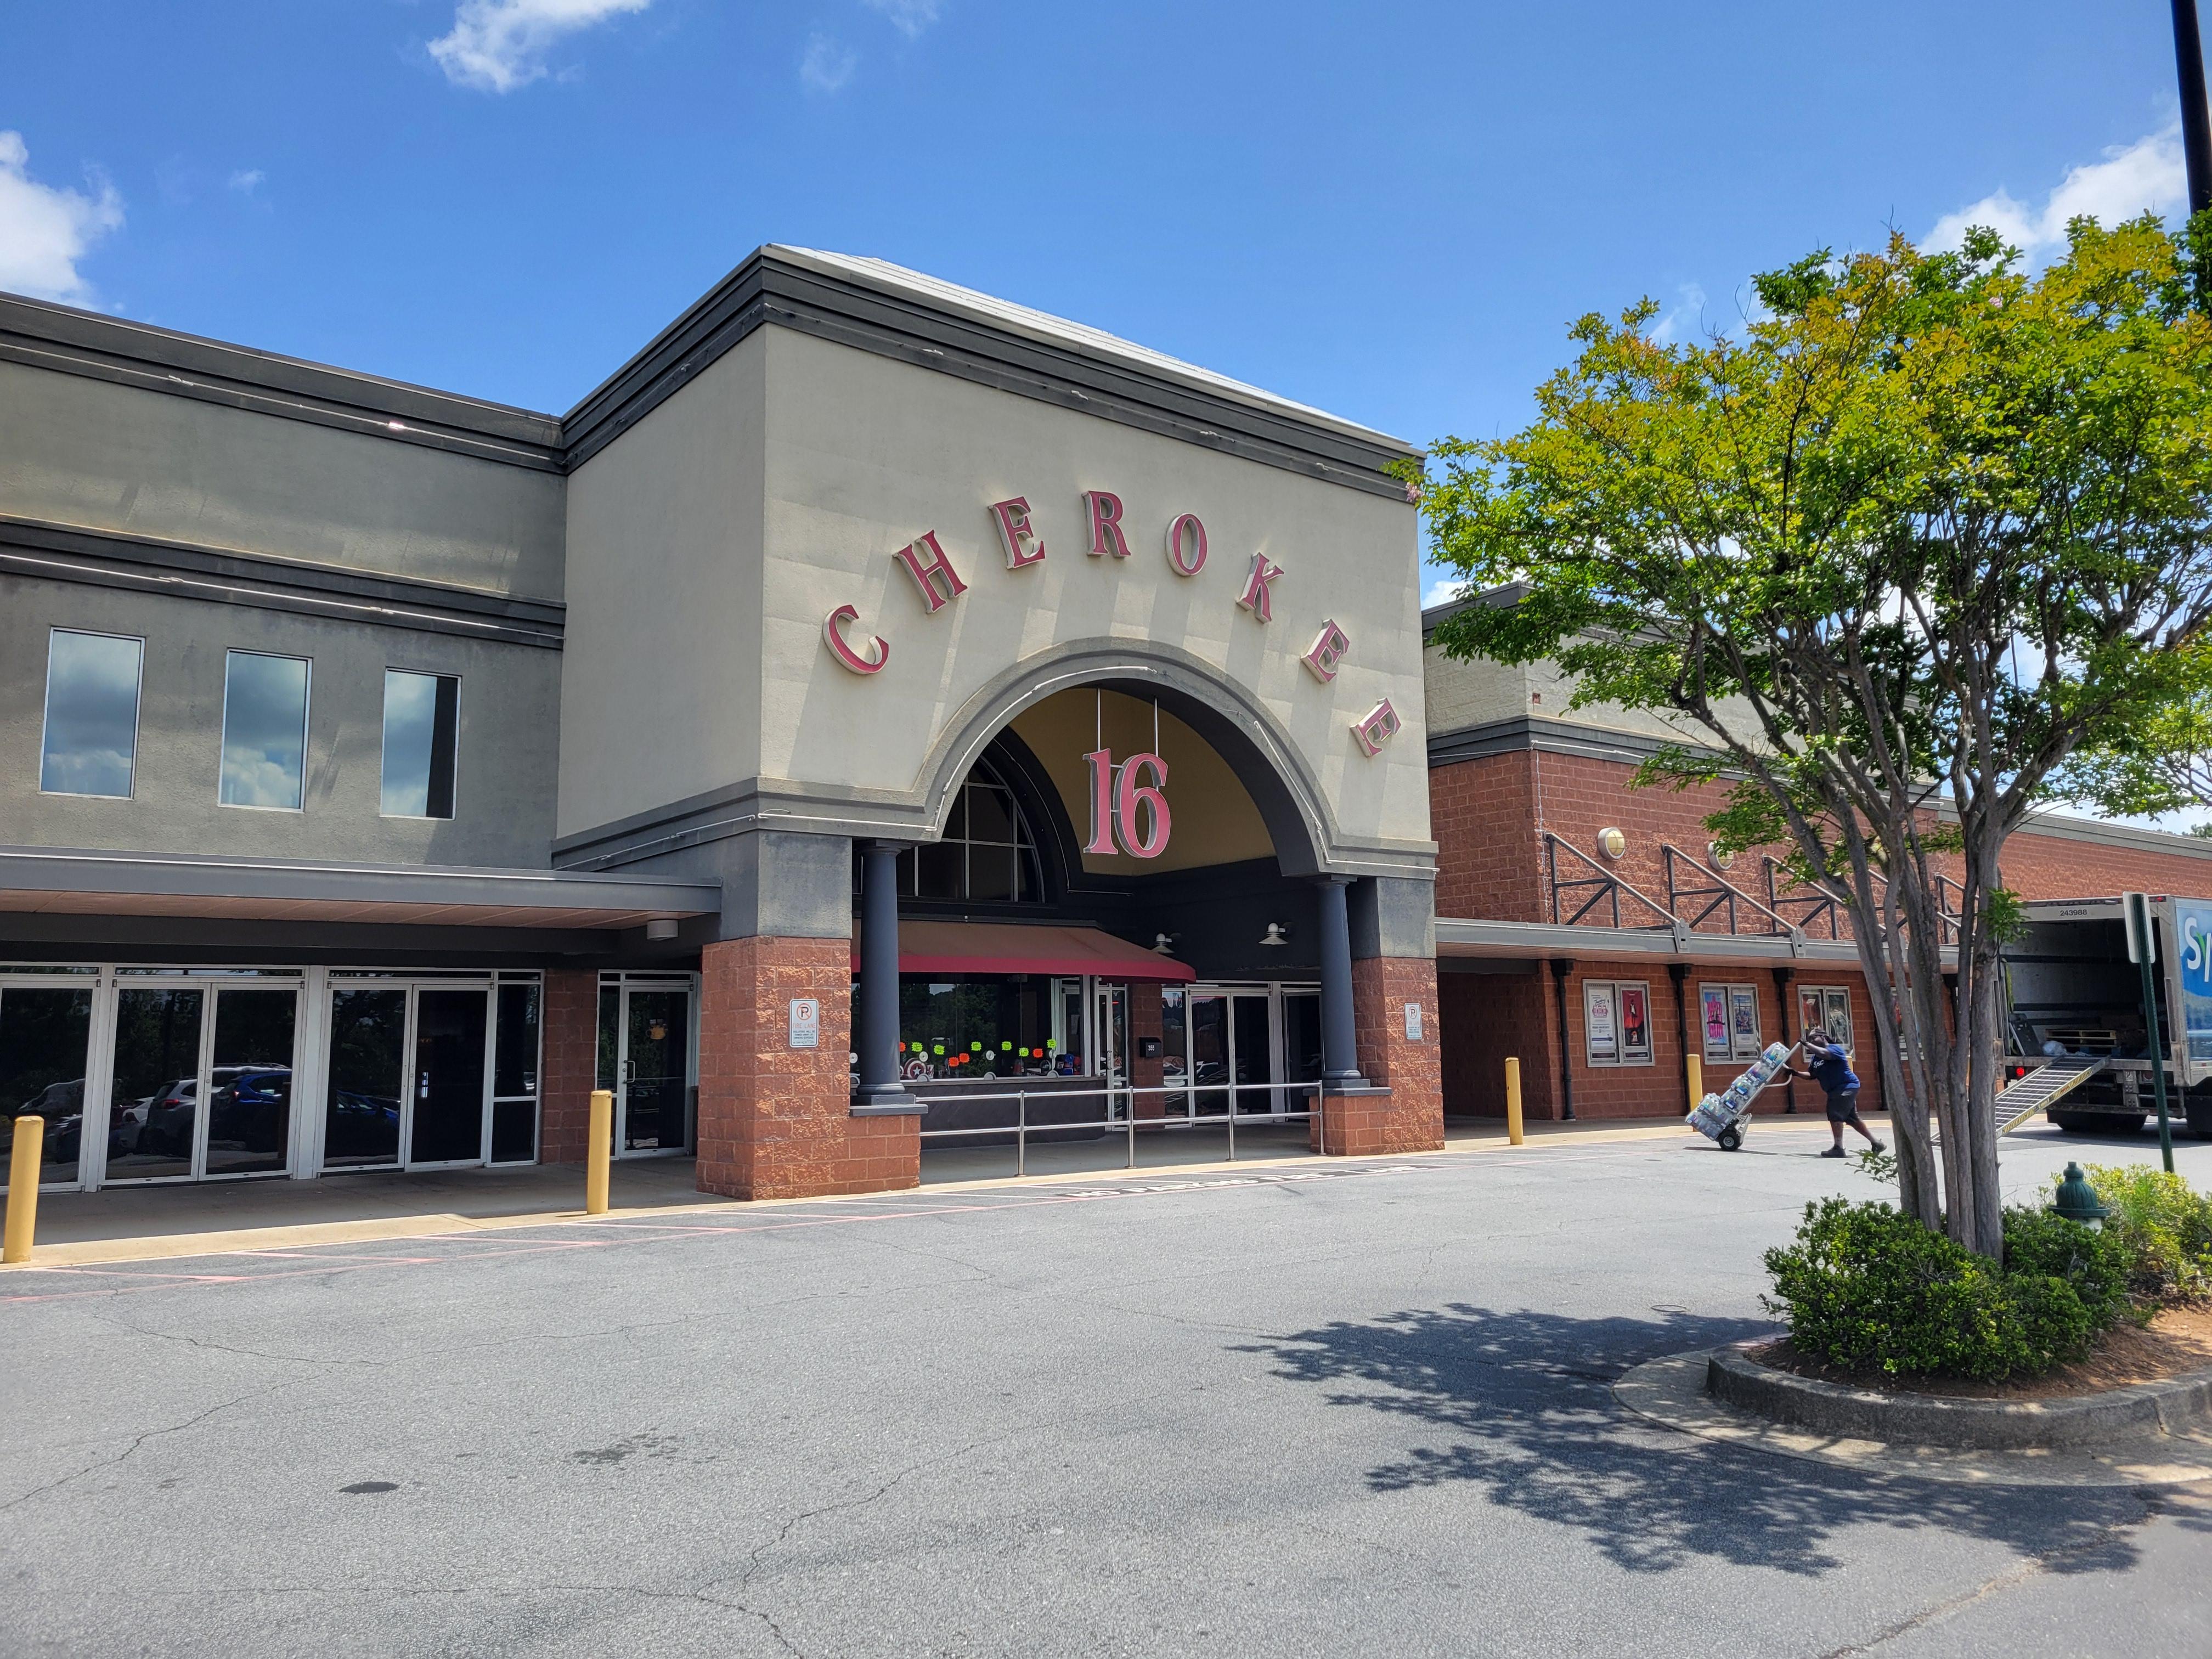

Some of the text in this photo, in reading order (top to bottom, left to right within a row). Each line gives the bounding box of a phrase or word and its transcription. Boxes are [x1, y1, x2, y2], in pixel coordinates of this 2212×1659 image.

[822, 490, 1402, 758] CHEROKEE
[1083, 748, 1171, 859] 16
[2185, 917, 2212, 982] Sy
[1122, 1179, 1259, 1193] PARKING
[1260, 1173, 1336, 1182] FIRE
[1345, 1166, 1429, 1174] LANE
